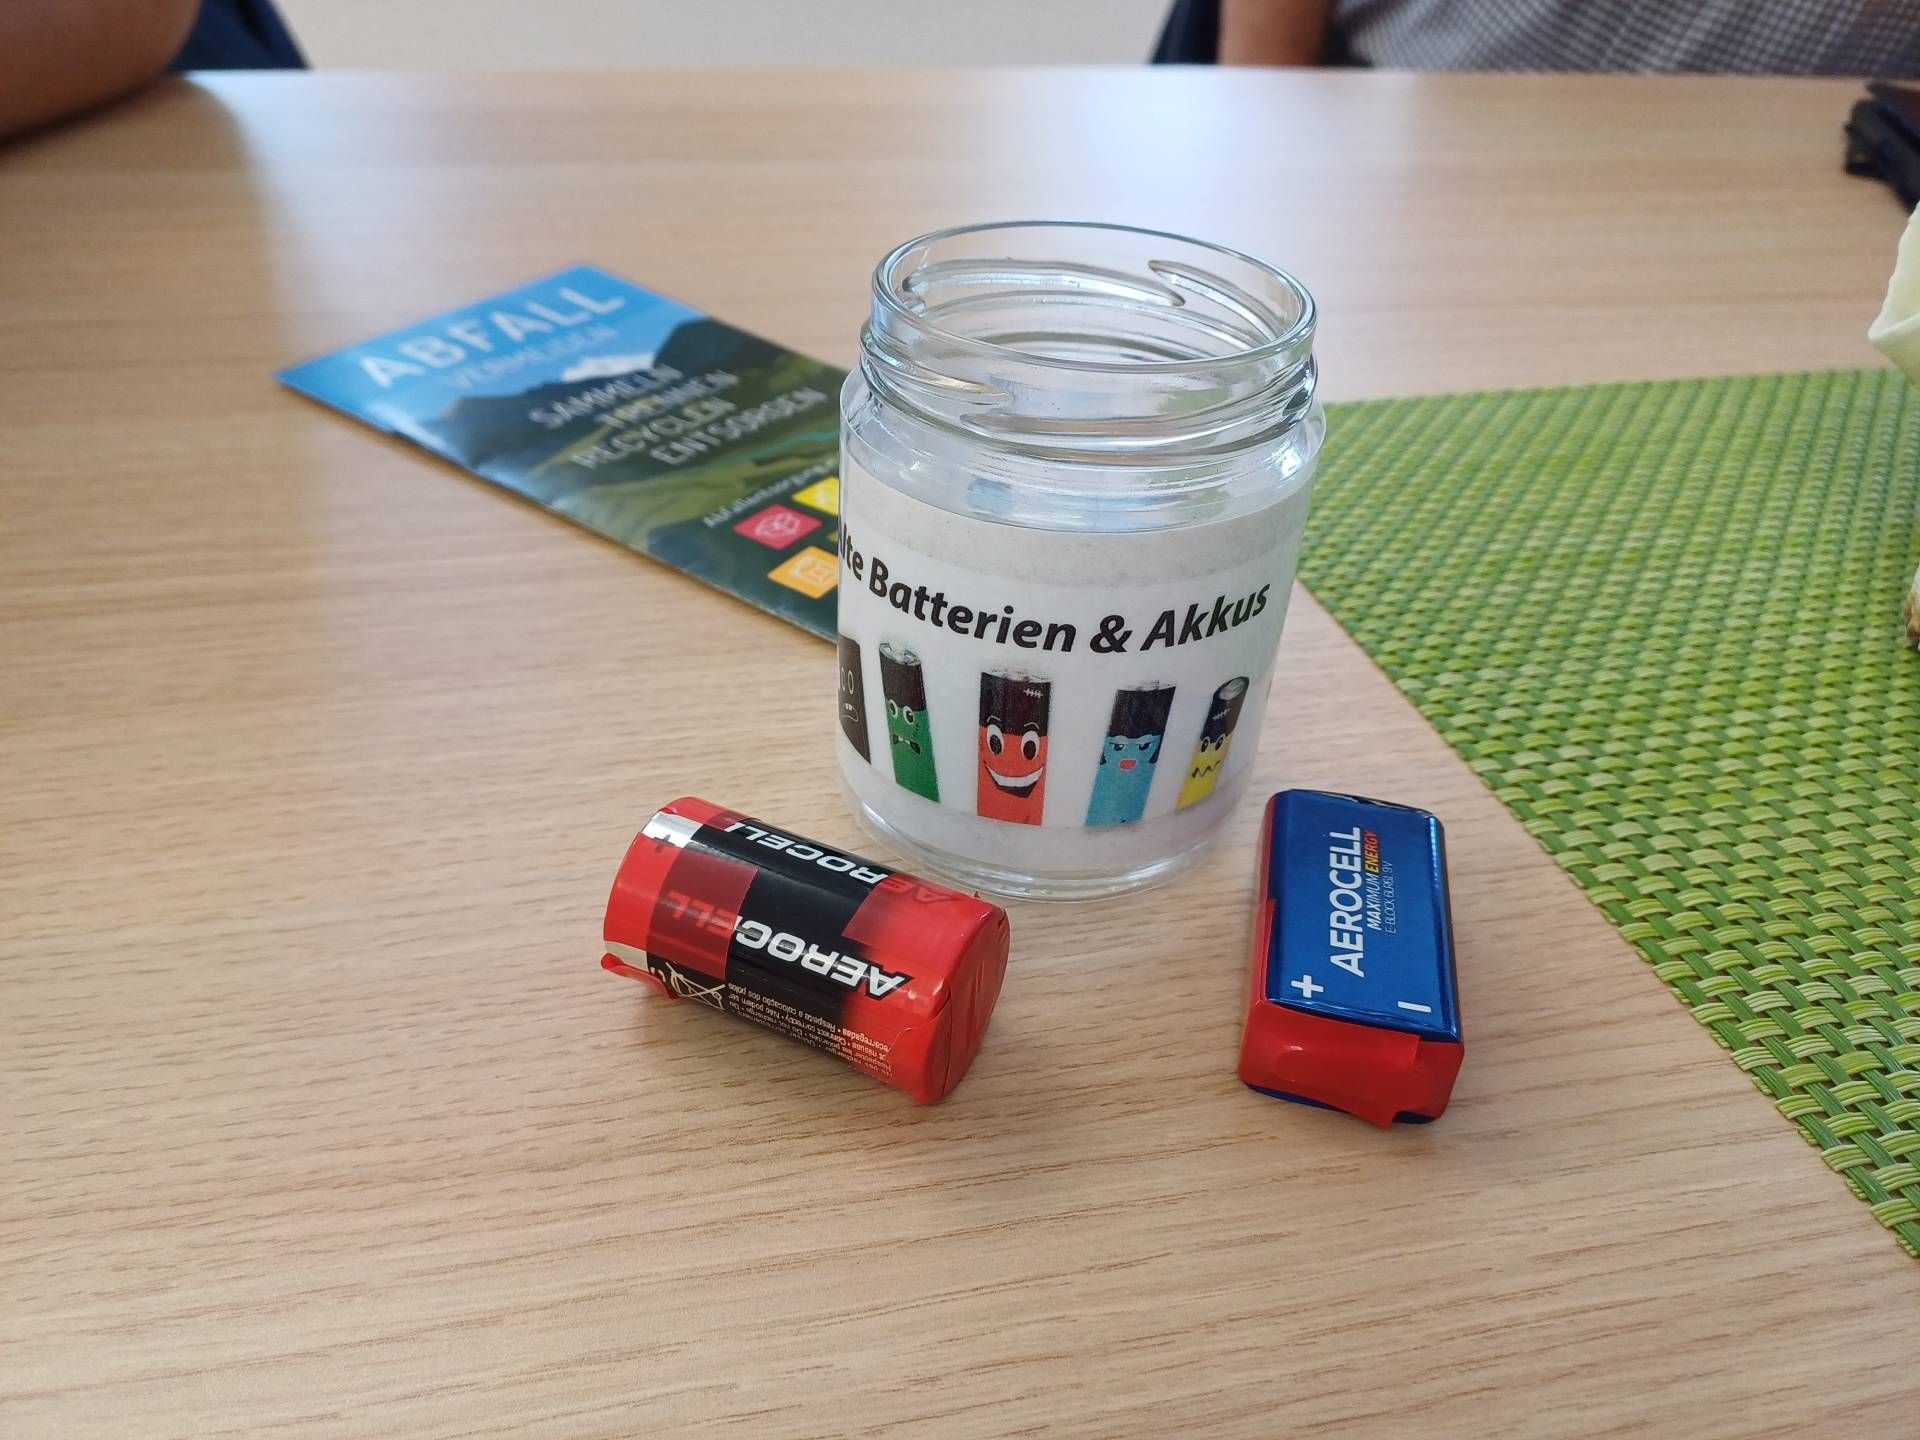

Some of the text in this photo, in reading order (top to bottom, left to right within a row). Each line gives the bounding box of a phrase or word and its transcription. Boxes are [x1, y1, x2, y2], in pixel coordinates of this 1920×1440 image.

[360, 287, 625, 388] ABFALL
[529, 363, 684, 428] SAMMELN
[650, 387, 828, 465] ENTSORGEN
[869, 556, 1077, 653] Batterien
[1089, 614, 1132, 654] &
[1140, 583, 1271, 652] Akkus
[1329, 826, 1365, 978] AEROCELL
[1364, 830, 1382, 931] MAXIMUM ENERGY
